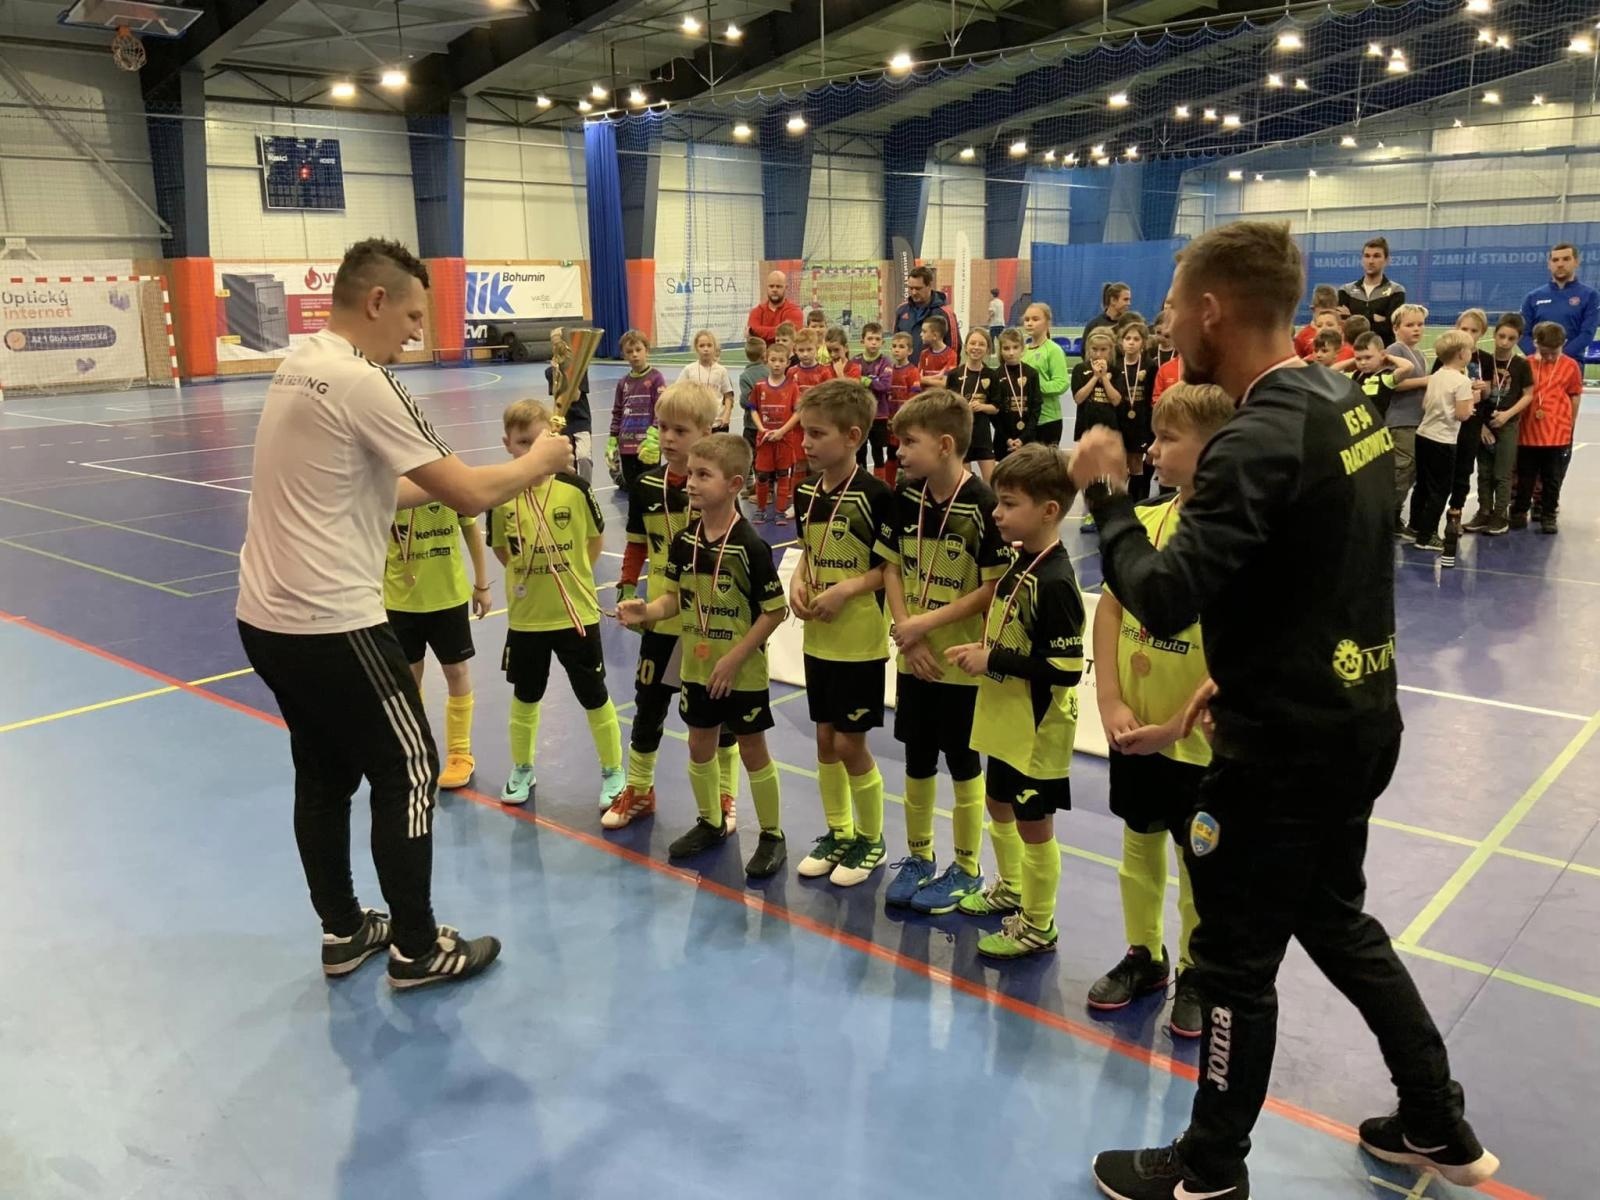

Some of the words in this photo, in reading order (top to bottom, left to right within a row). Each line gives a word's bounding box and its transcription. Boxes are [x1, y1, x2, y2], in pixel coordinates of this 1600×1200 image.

[3, 307, 73, 320] internet
[415, 524, 454, 541] kensol
[708, 628, 733, 641] auto
[1153, 638, 1190, 655] auto
